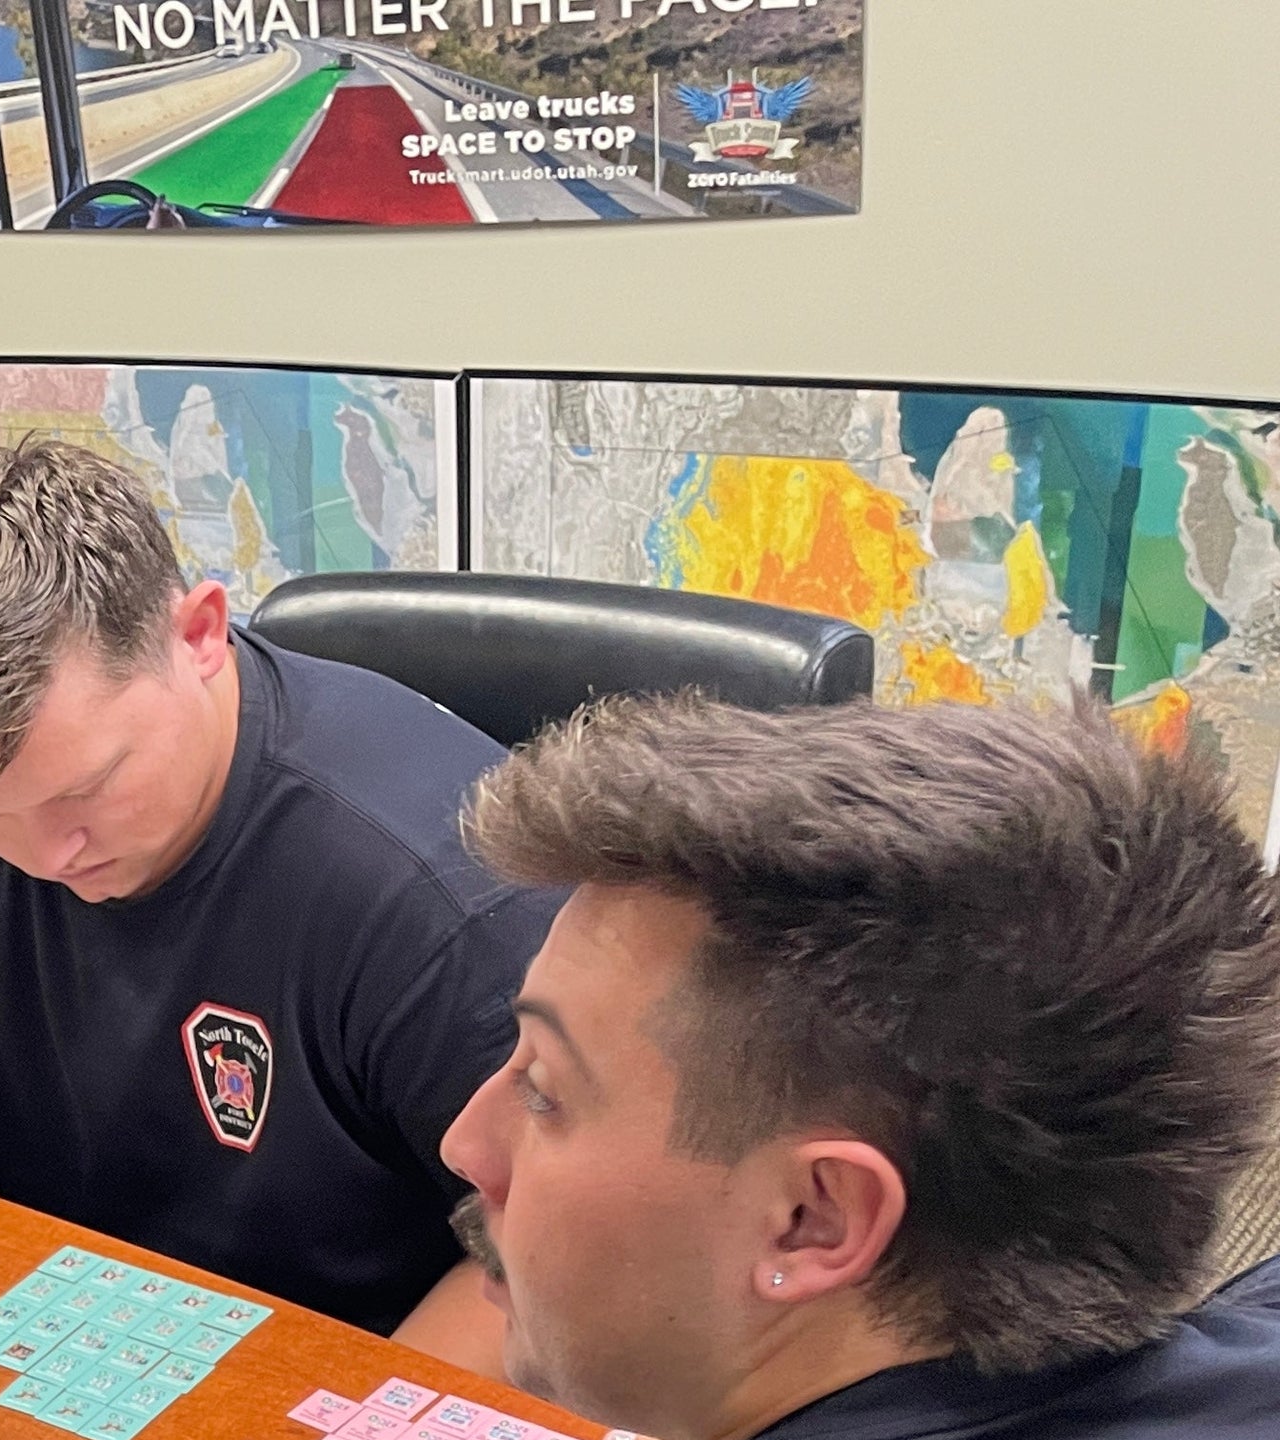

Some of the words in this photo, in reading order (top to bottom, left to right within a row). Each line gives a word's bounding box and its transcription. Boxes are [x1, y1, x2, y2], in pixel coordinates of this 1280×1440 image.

[114, 0, 196, 51] NO
[445, 99, 531, 122] Leave
[537, 91, 636, 118] trucks
[401, 131, 497, 158] SPACE
[503, 130, 546, 154] TO
[553, 125, 637, 152] STOP
